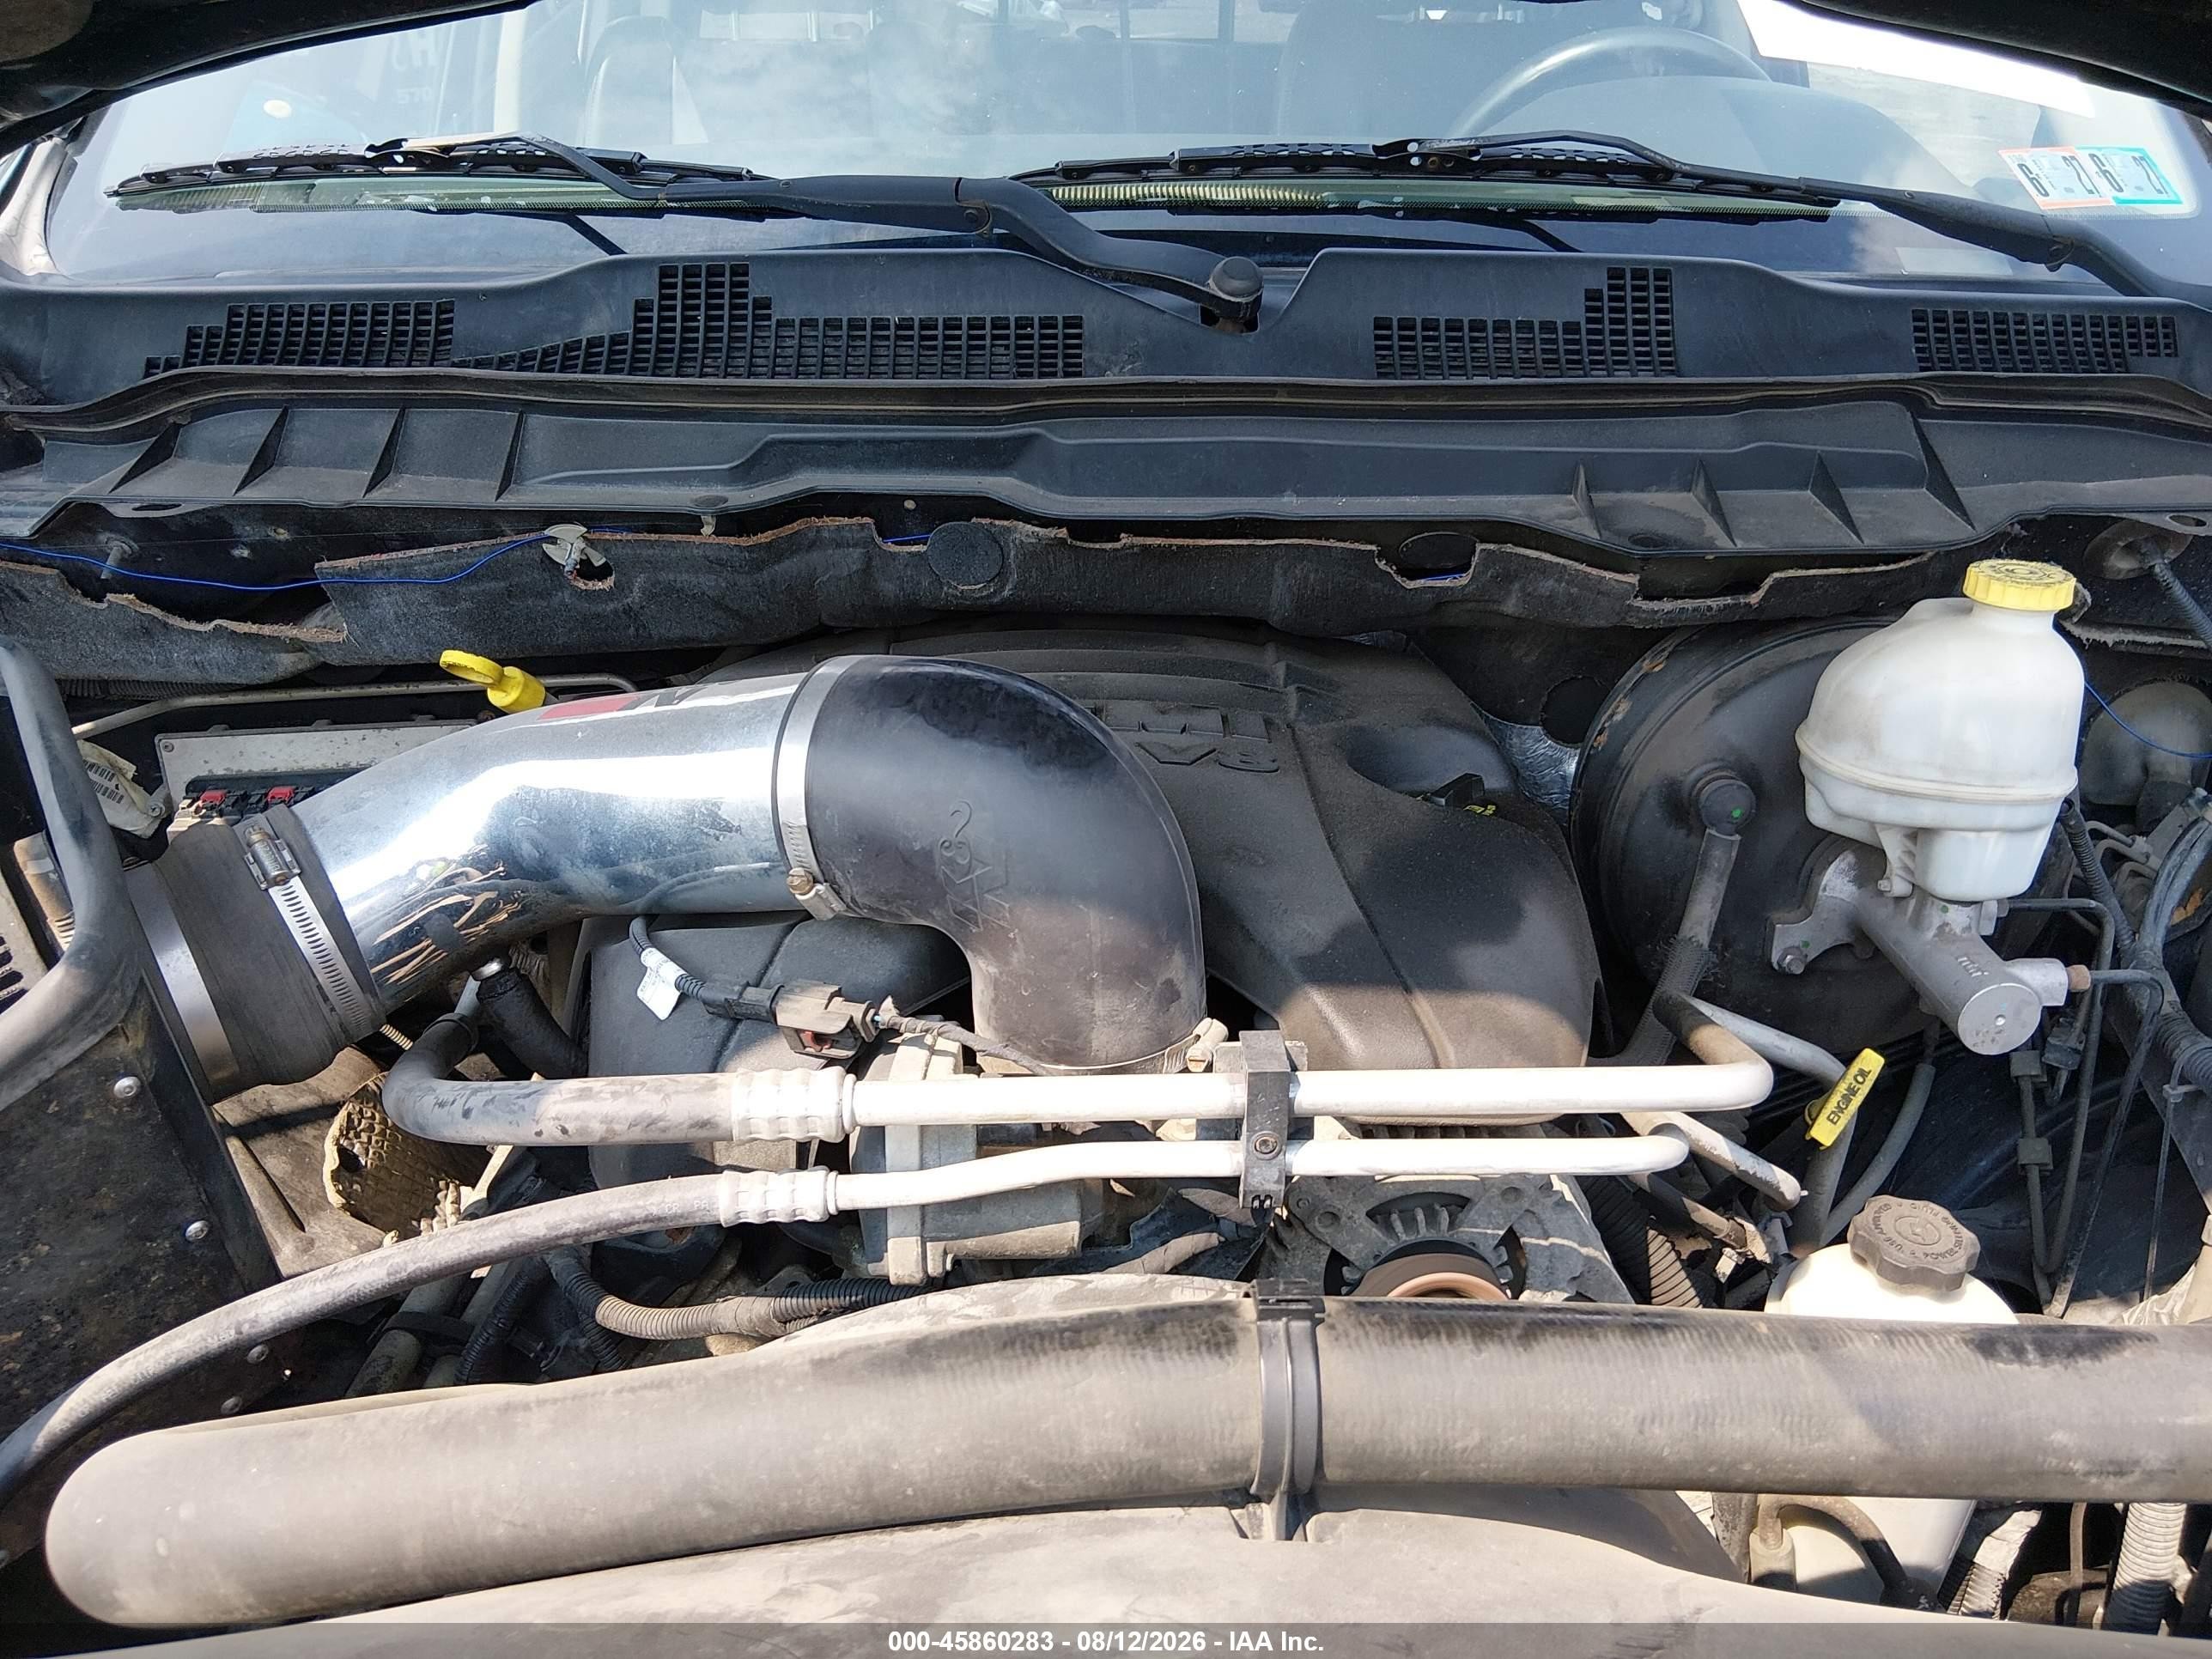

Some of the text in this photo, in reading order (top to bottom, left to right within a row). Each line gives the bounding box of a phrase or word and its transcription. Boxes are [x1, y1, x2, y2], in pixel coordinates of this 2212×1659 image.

[2017, 163, 2050, 198] 6
[2088, 153, 2124, 193] 6
[1826, 1067, 1873, 1126] ENGINE OIL
